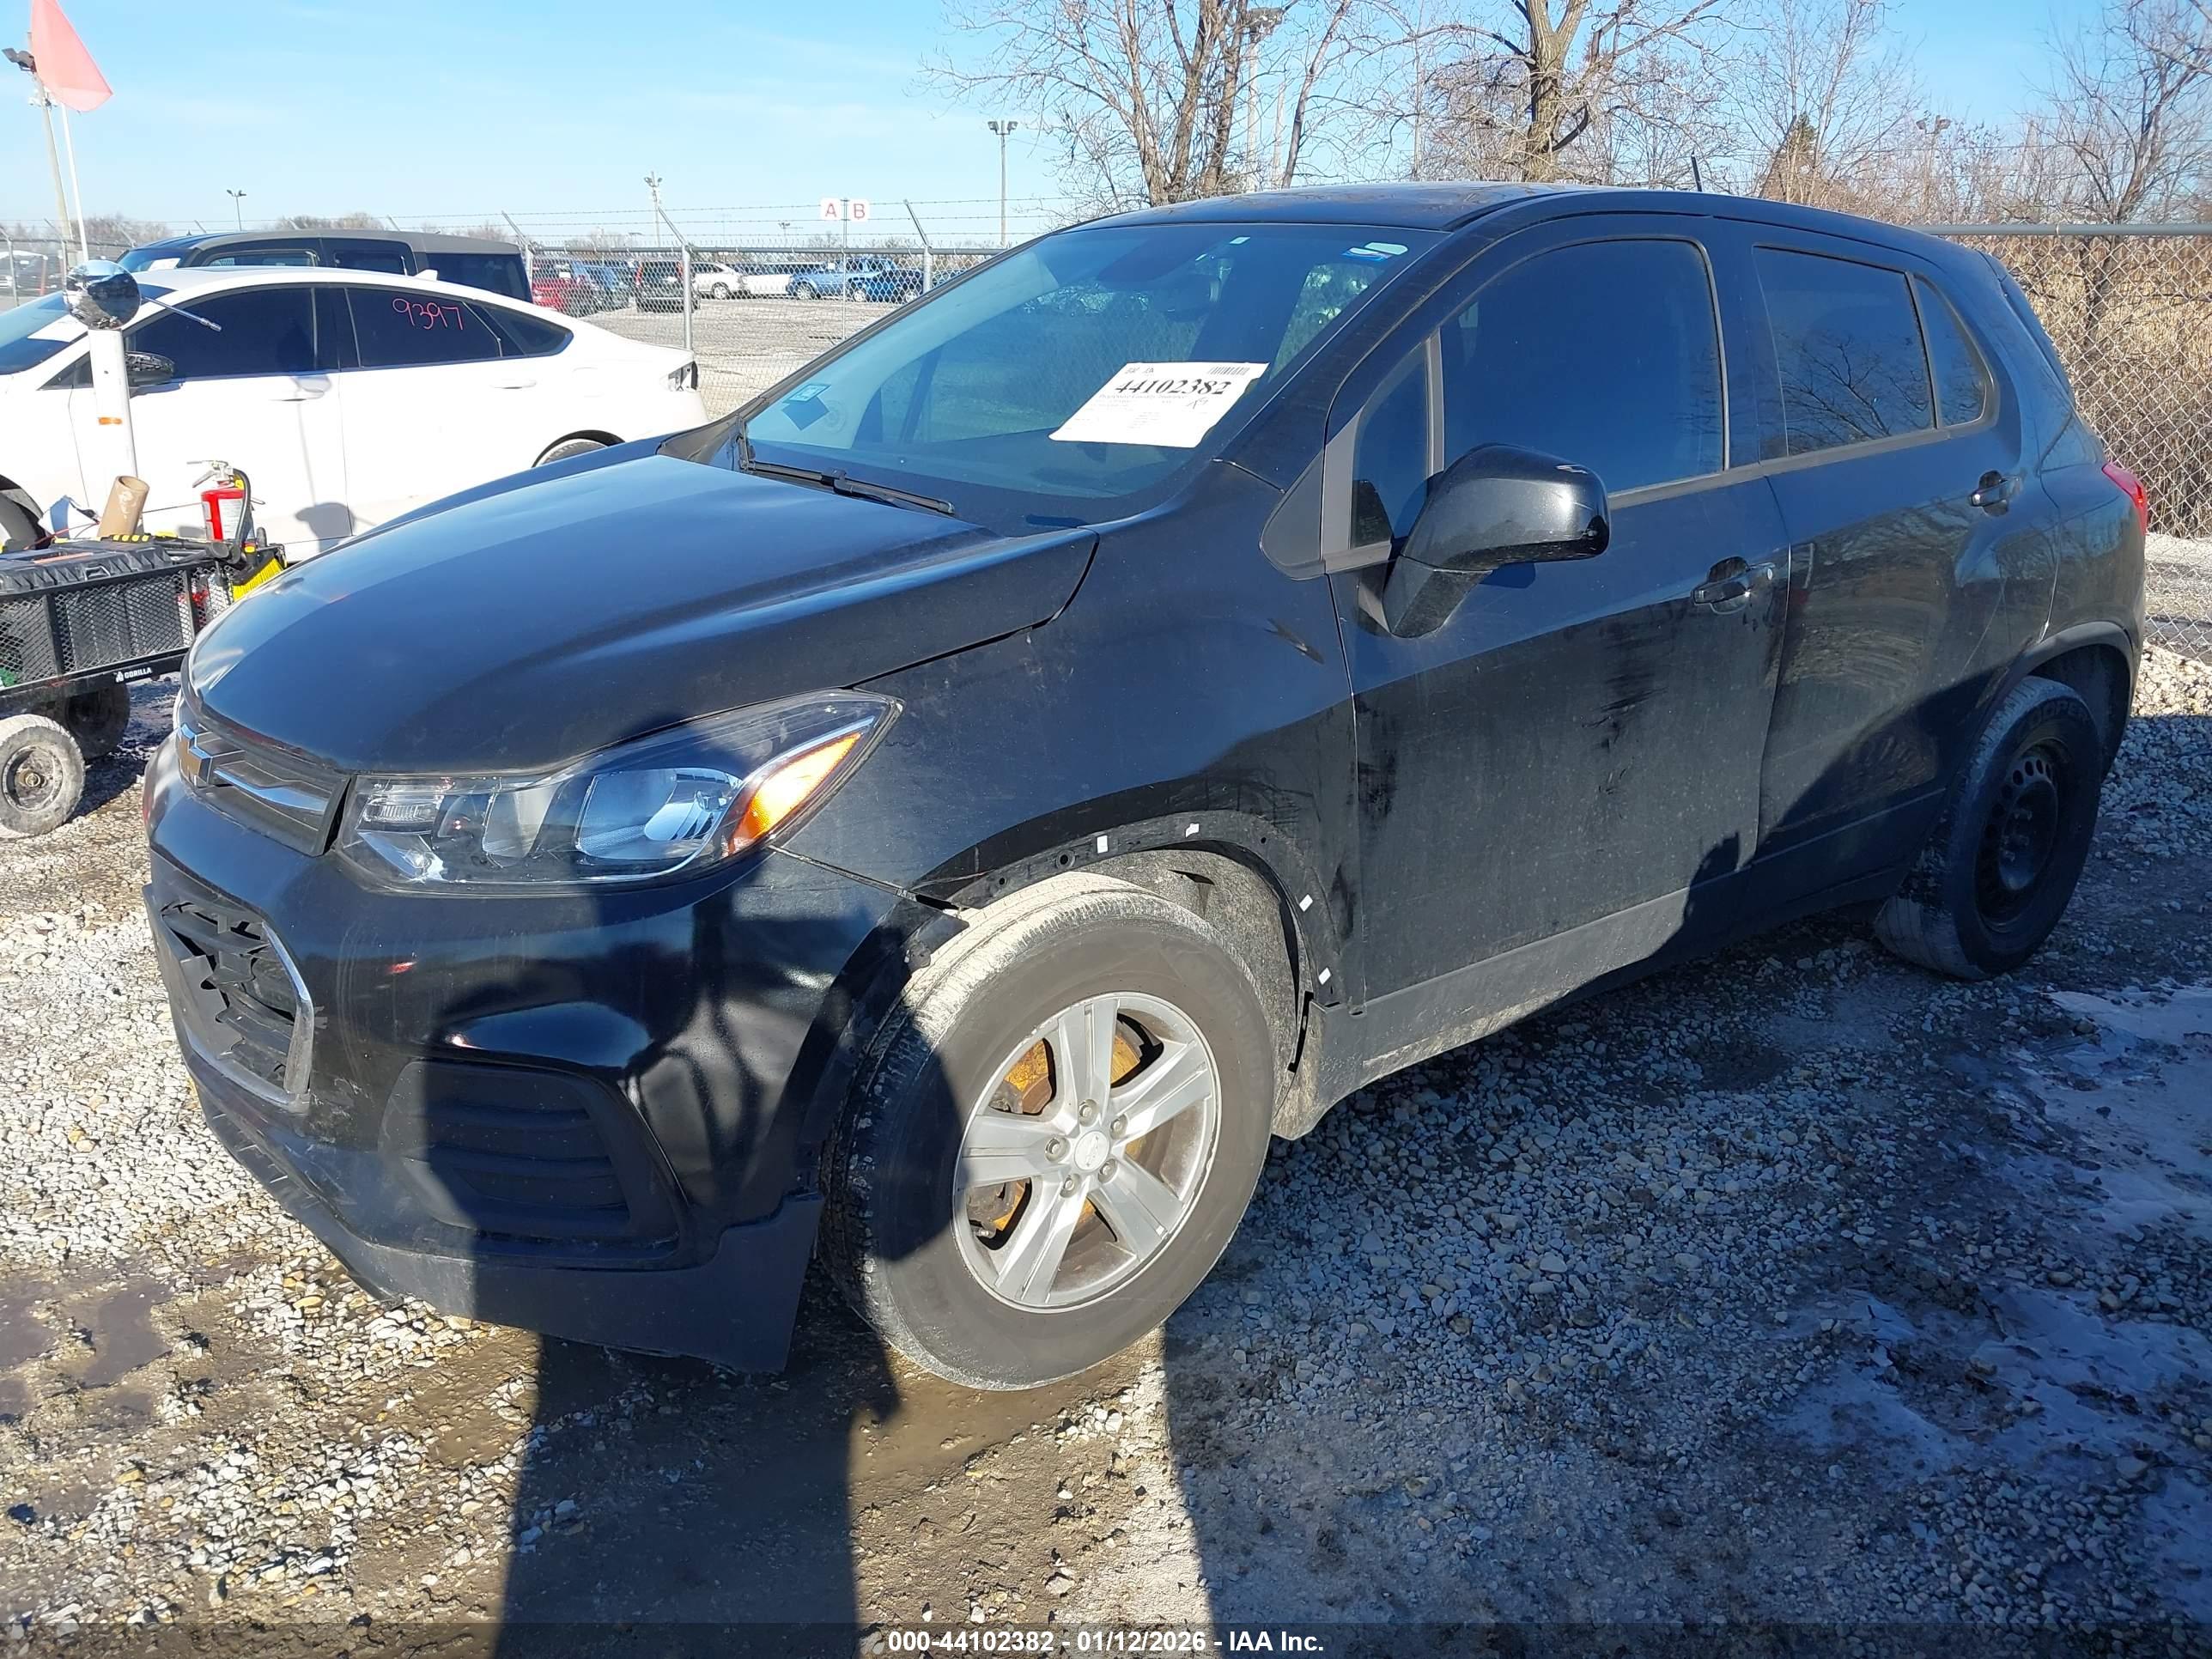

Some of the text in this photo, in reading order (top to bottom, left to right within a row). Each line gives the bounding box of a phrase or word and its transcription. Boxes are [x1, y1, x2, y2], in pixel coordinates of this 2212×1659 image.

[825, 203, 837, 217] A
[854, 203, 865, 219] B
[392, 298, 464, 331] 9397
[1115, 379, 1232, 395] 44102382
[124, 666, 152, 679] GORILLA
